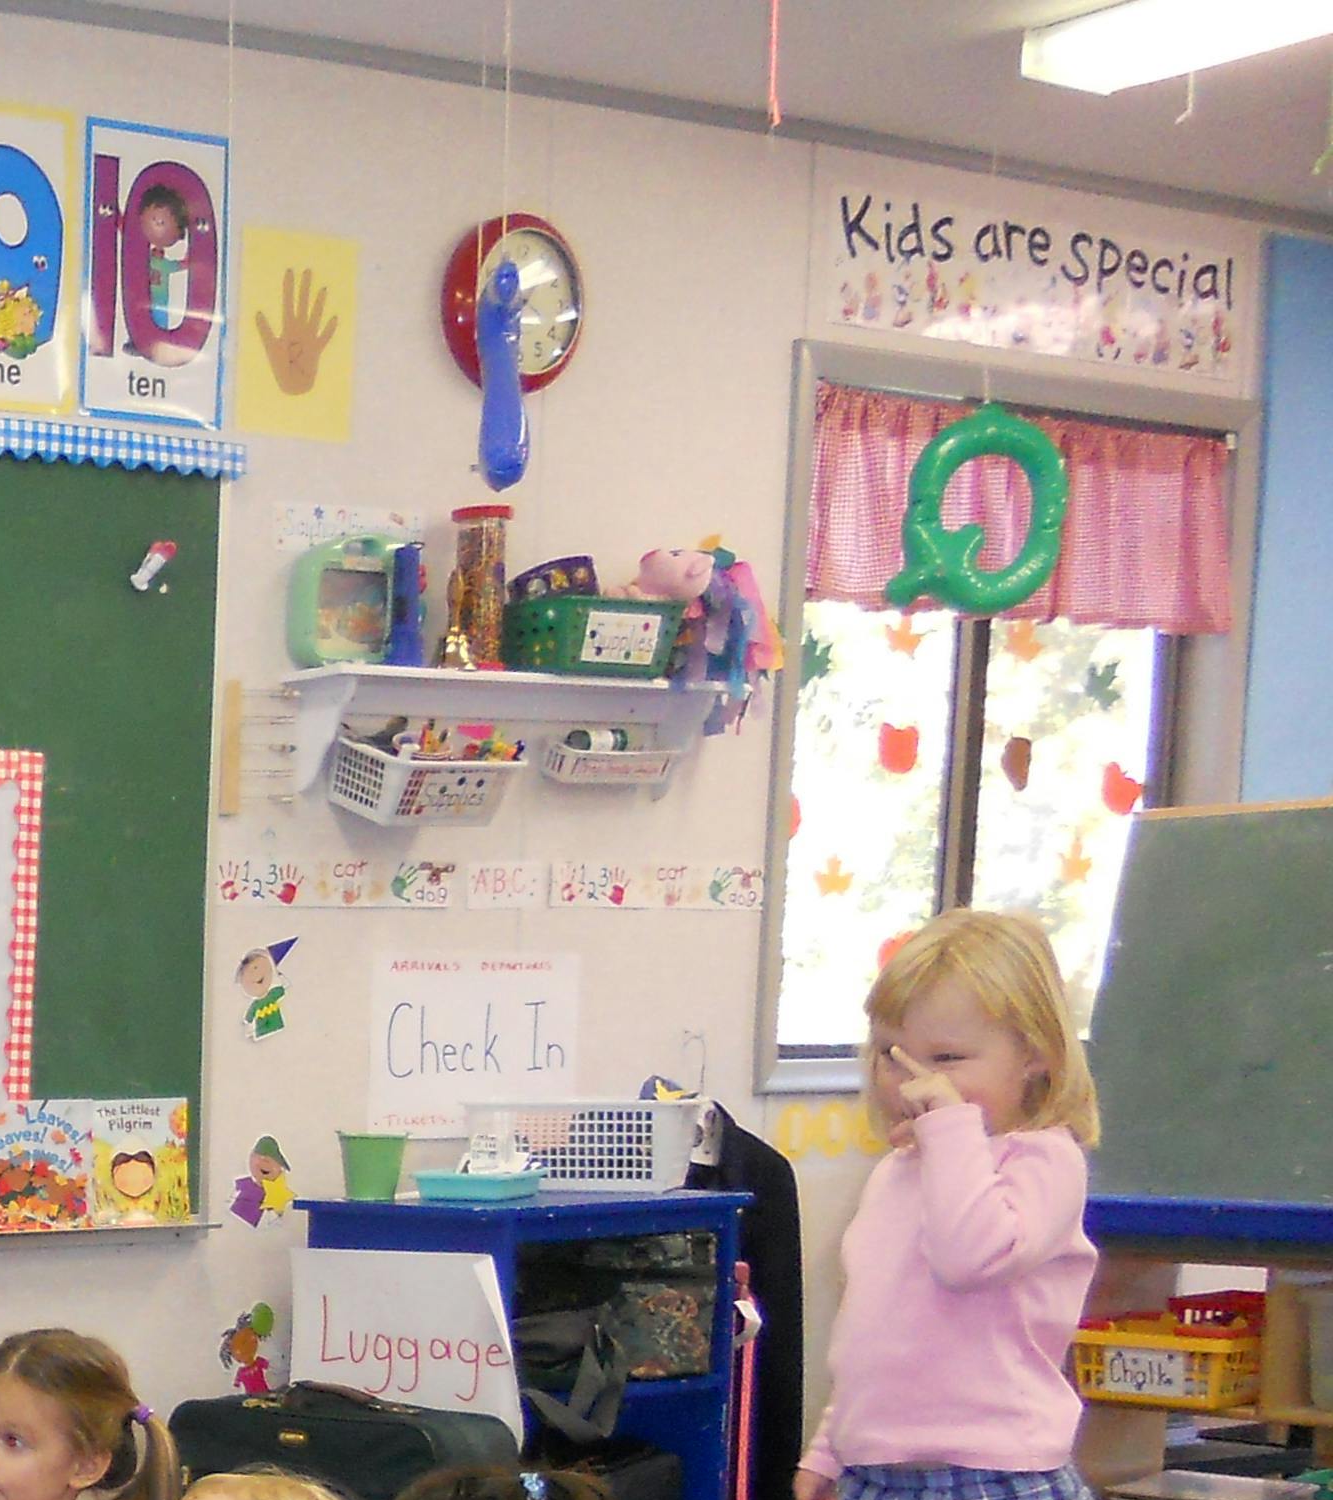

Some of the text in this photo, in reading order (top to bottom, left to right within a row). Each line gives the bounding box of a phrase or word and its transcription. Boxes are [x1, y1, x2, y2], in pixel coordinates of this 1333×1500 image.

[840, 196, 954, 264] Kids
[974, 221, 1051, 267] are
[92, 152, 217, 368] 10
[127, 370, 166, 399] ten
[885, 400, 1068, 614] Q
[241, 860, 250, 883] 1
[266, 863, 278, 885] 3
[333, 860, 368, 878] cat
[251, 878, 265, 899] 2
[387, 1000, 565, 1079] Check In
[97, 1104, 161, 1118] The Littlest
[108, 1118, 153, 1133] Pilgrim
[320, 1294, 510, 1402] Luggage
[1109, 1355, 1173, 1390] Chalk
